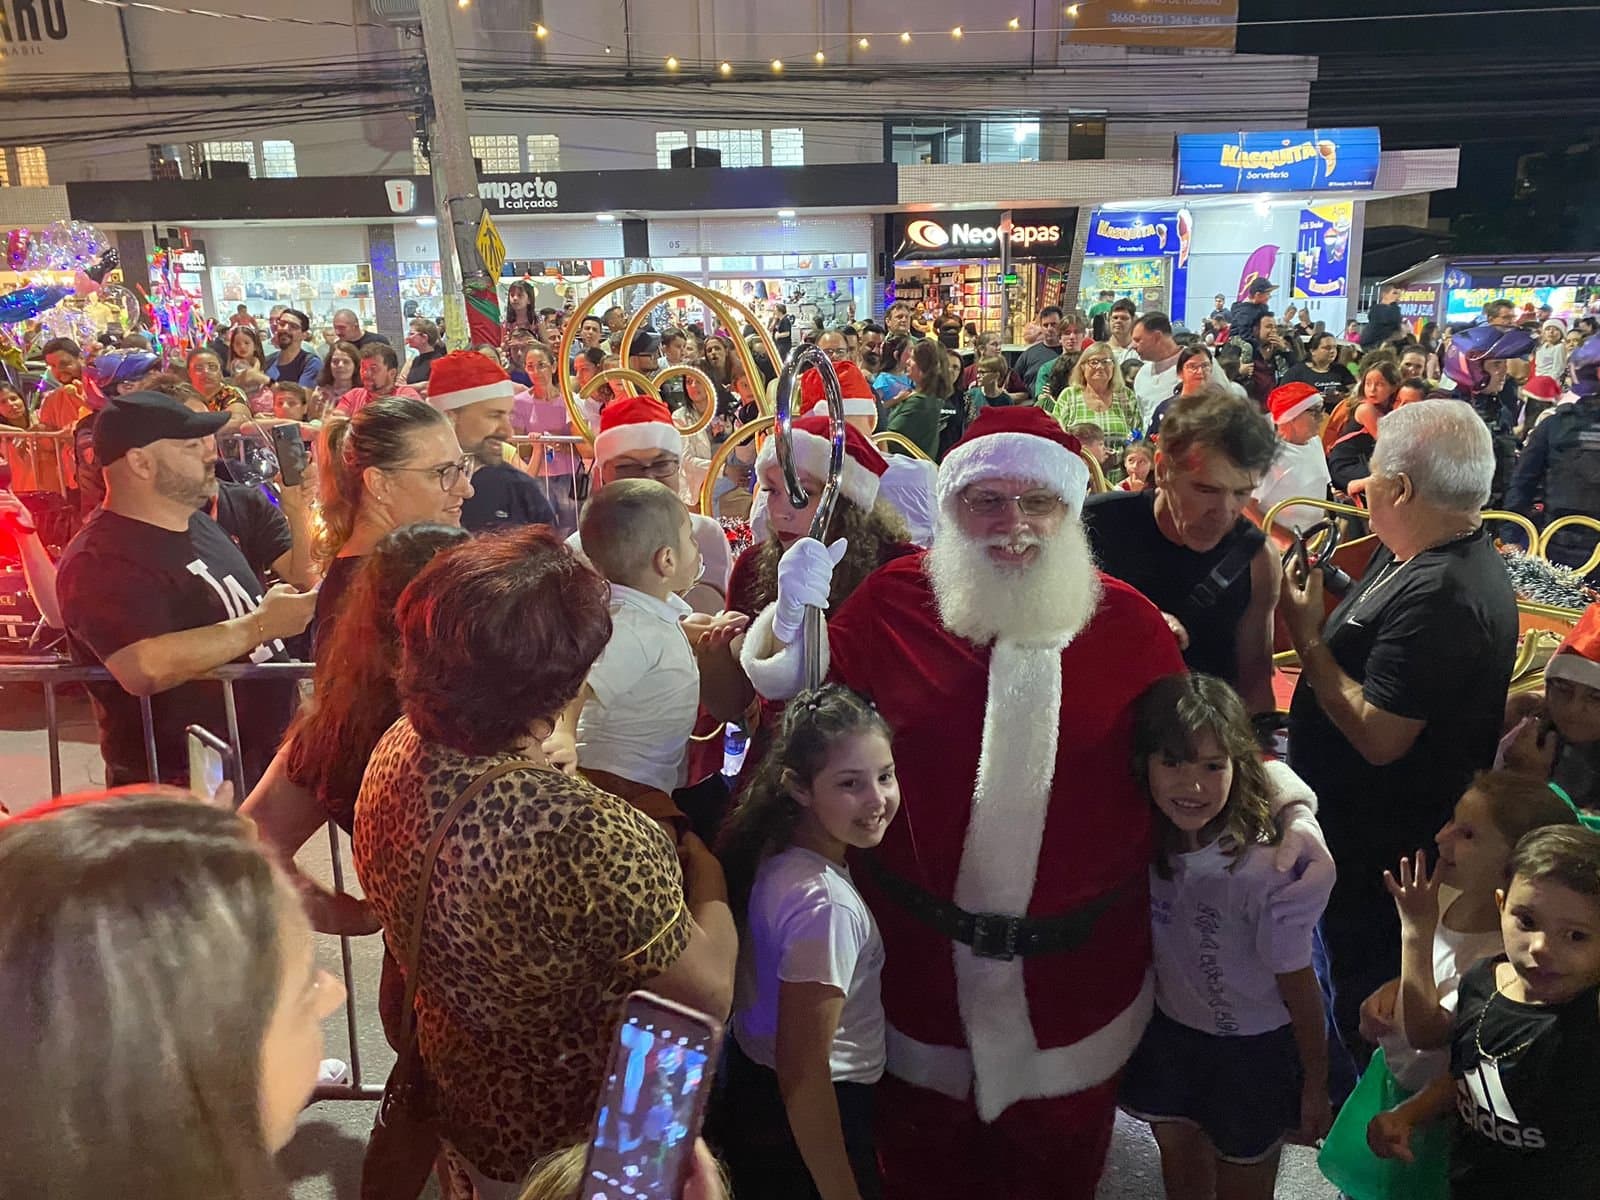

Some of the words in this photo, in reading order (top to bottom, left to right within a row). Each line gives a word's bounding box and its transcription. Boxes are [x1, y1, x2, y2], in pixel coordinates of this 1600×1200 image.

[477, 177, 558, 208] mpacto
[505, 199, 558, 210] calçados
[669, 240, 680, 248] 05
